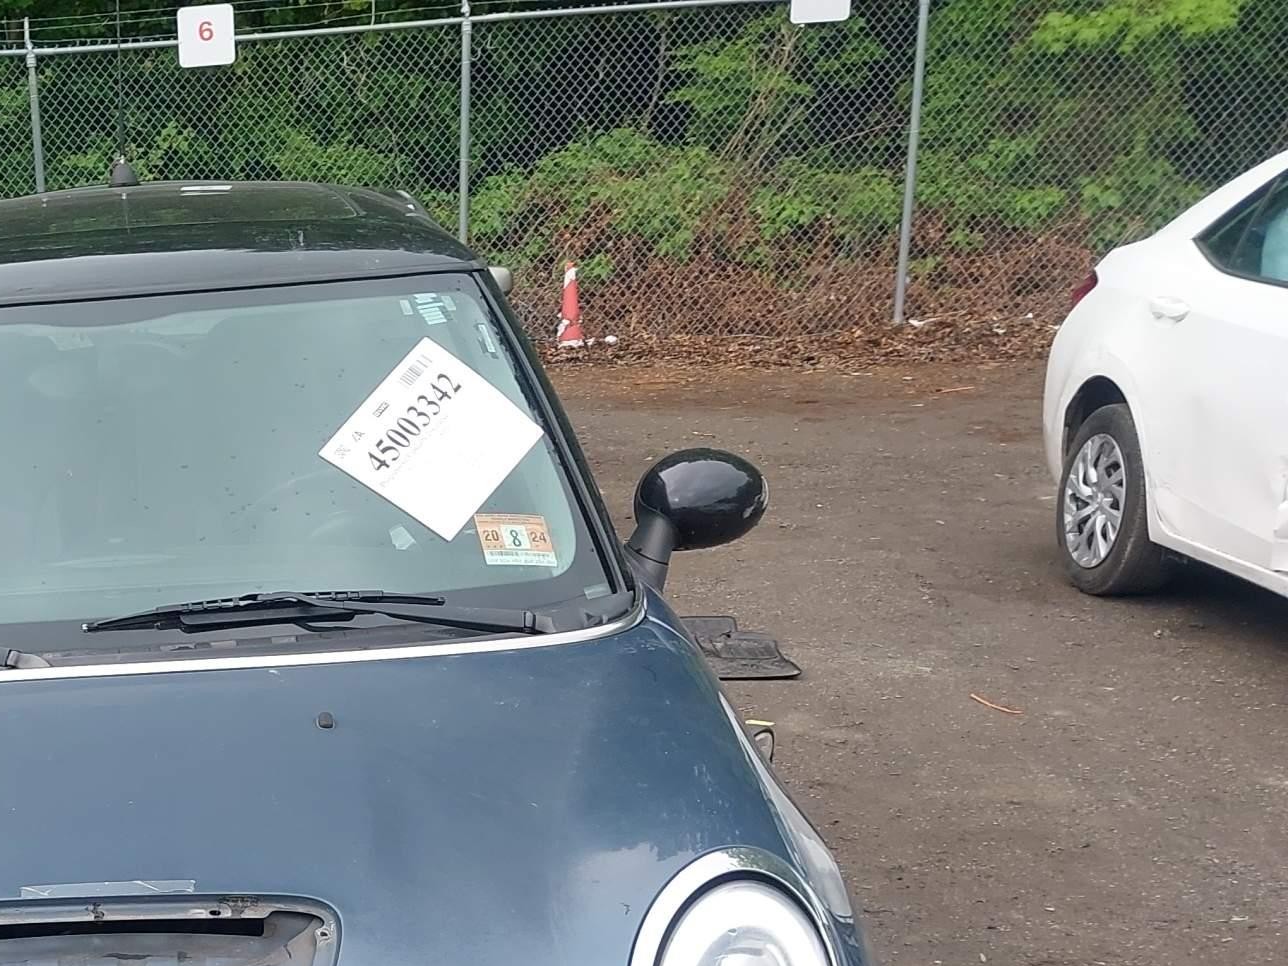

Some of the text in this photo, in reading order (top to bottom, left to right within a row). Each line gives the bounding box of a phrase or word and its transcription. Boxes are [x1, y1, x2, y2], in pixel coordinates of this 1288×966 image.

[198, 21, 214, 41] 6
[368, 373, 462, 471] 45003342
[482, 529, 548, 547] 20 8 24
